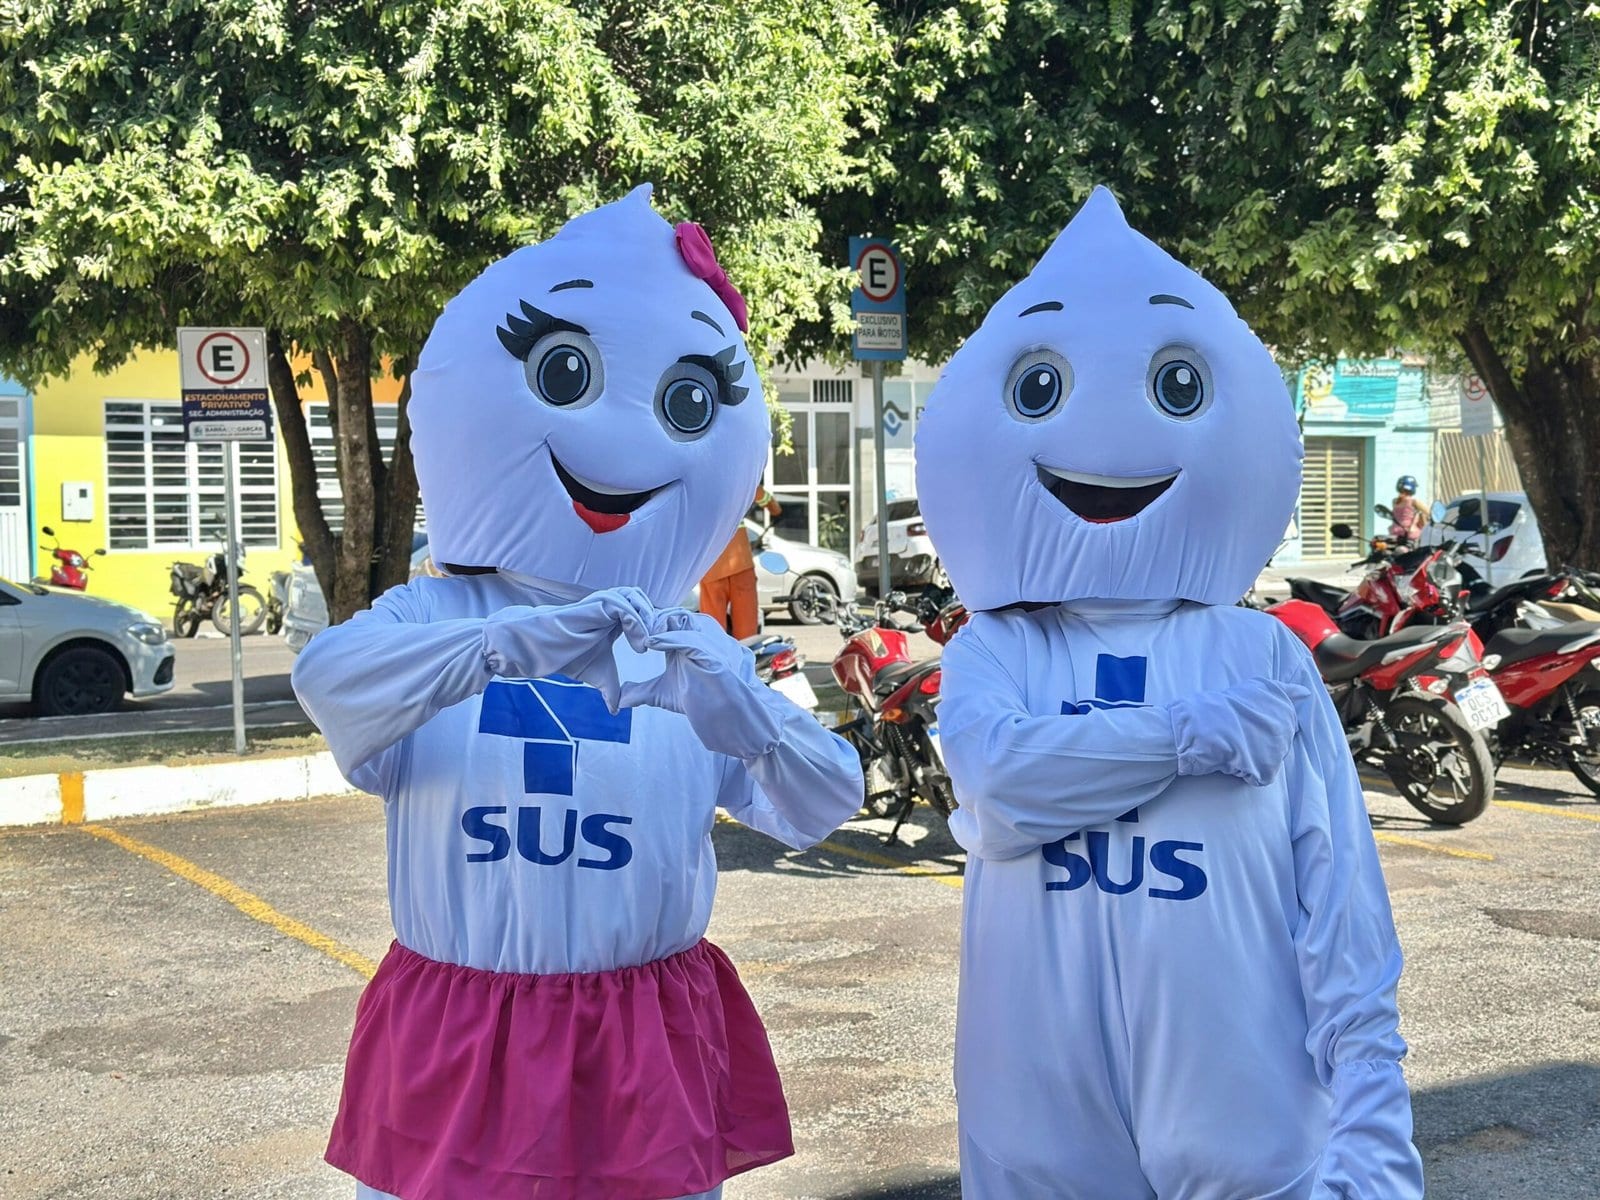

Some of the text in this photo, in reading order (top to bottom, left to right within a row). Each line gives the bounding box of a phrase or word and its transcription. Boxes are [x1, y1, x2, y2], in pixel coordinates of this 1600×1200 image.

[869, 257, 888, 289] E
[860, 315, 897, 326] EXCLUSIVO
[858, 327, 876, 338] PARA
[212, 345, 235, 372] E
[185, 393, 266, 401] ESTACIONAMENTO
[201, 401, 251, 409] PRIVATIVO
[205, 408, 265, 417] ADMINISTRAÇÃO
[462, 806, 633, 870] SUS
[1042, 831, 1208, 900] SUS
